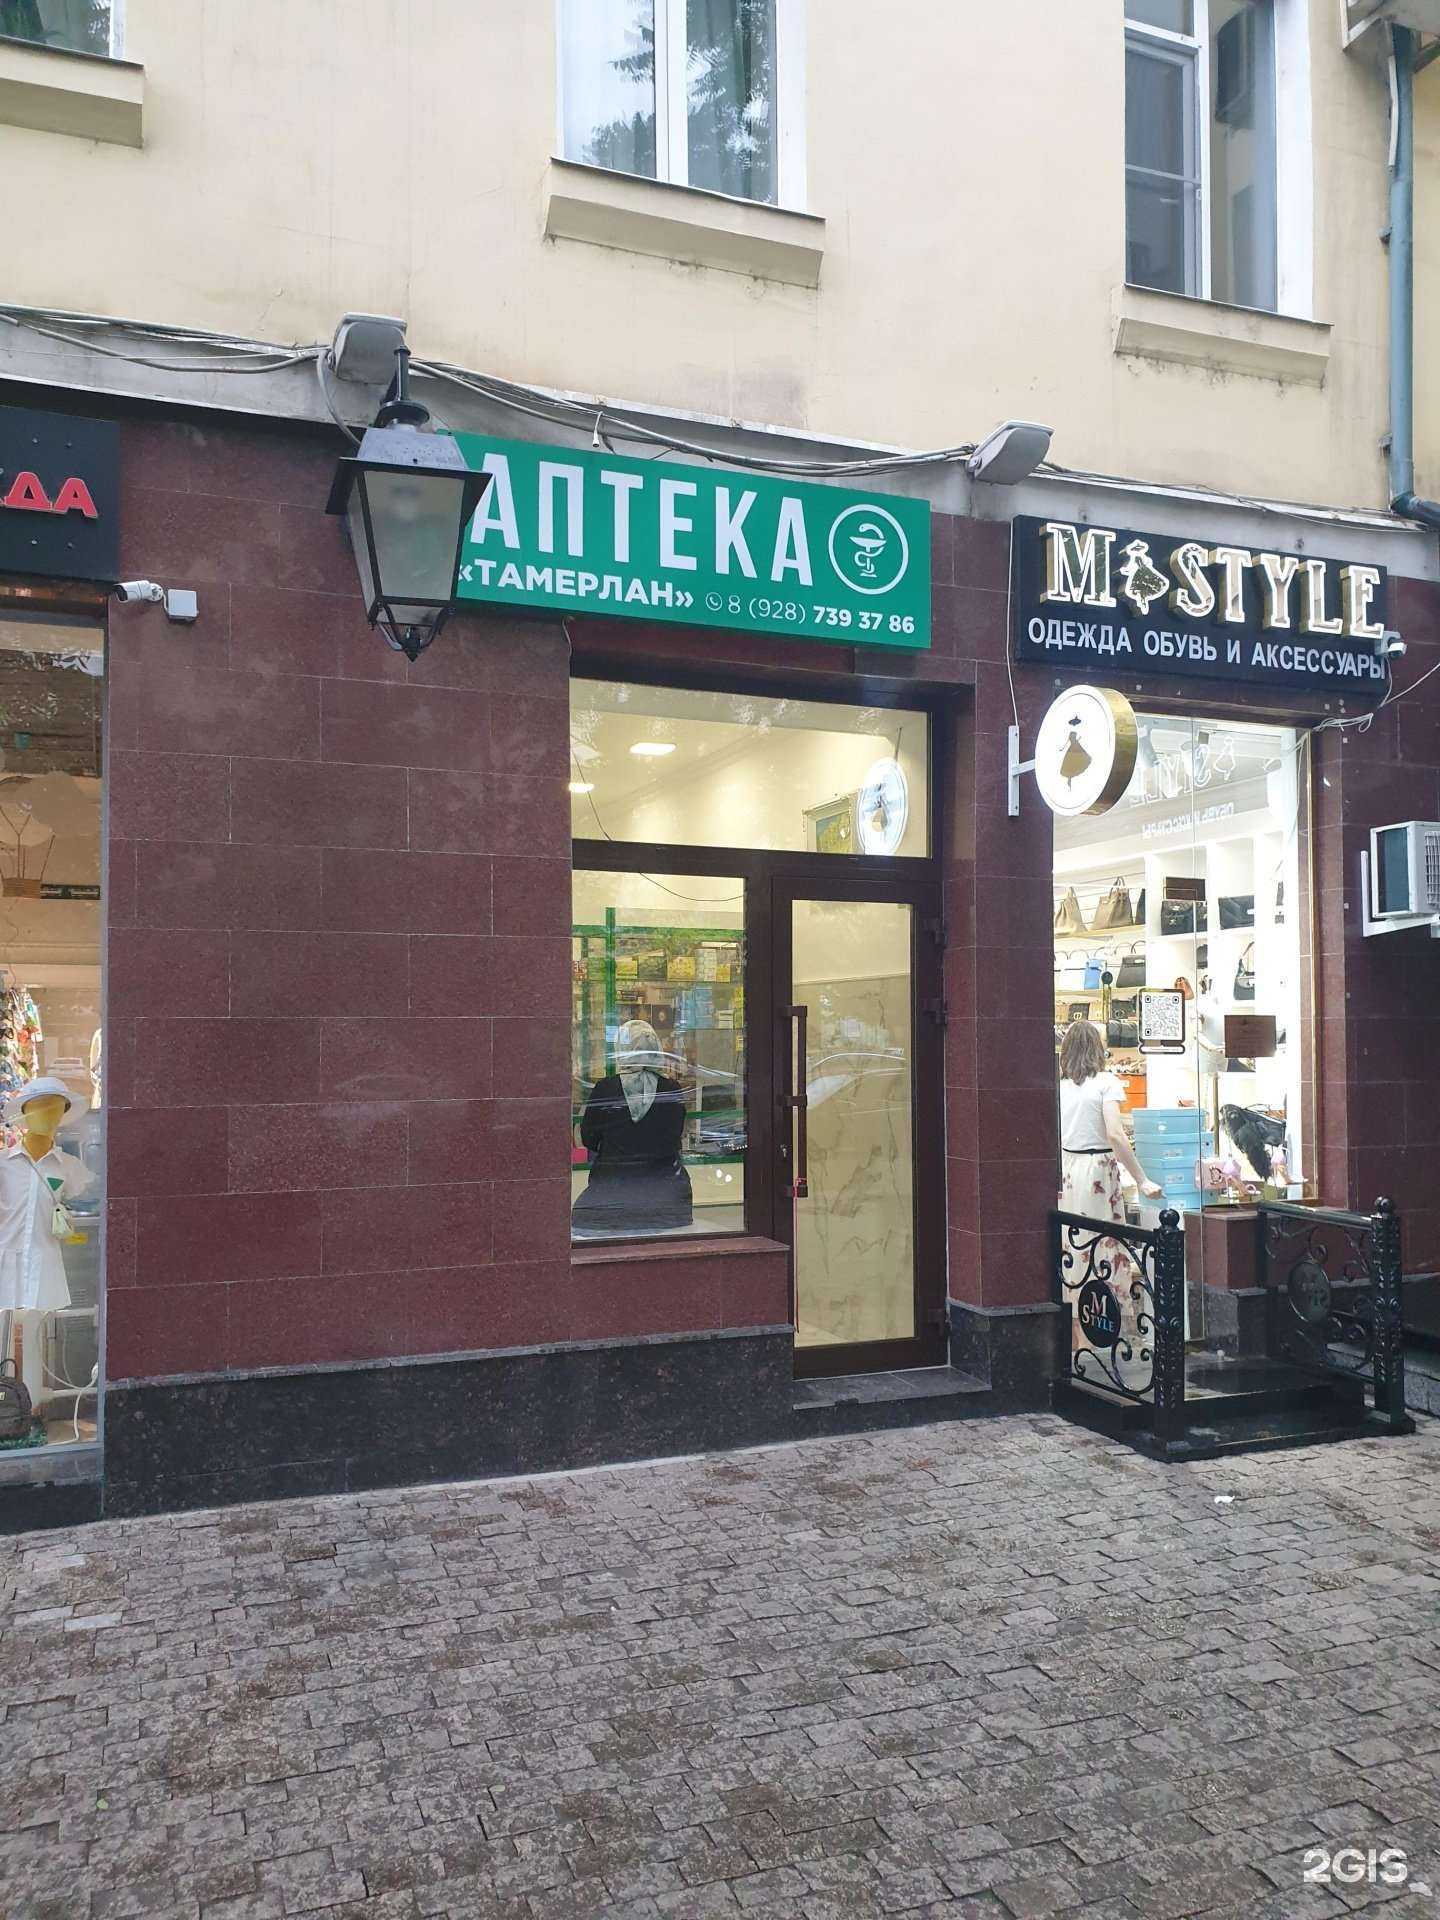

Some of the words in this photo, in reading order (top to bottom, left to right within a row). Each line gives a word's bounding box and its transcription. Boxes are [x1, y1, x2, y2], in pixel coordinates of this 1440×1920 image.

[0, 471, 98, 518] ДА
[470, 453, 814, 586] АПТЕКА
[459, 559, 694, 608] «ТАМЕРЛАН»
[1040, 523, 1117, 608] M
[1169, 543, 1385, 639] STYLE
[728, 595, 741, 614] 8
[749, 598, 806, 624] (928)
[812, 605, 852, 627] 739
[858, 611, 884, 630] 37
[888, 615, 915, 634] 86
[1028, 617, 1132, 654] ОДЕЖДА
[1143, 630, 1217, 661] ОБУВЬ
[1227, 640, 1241, 664] И
[1251, 642, 1386, 680] АКСЕССУАРЫ
[1082, 1304, 1114, 1333] STYLE
[1090, 1291, 1108, 1318] M
